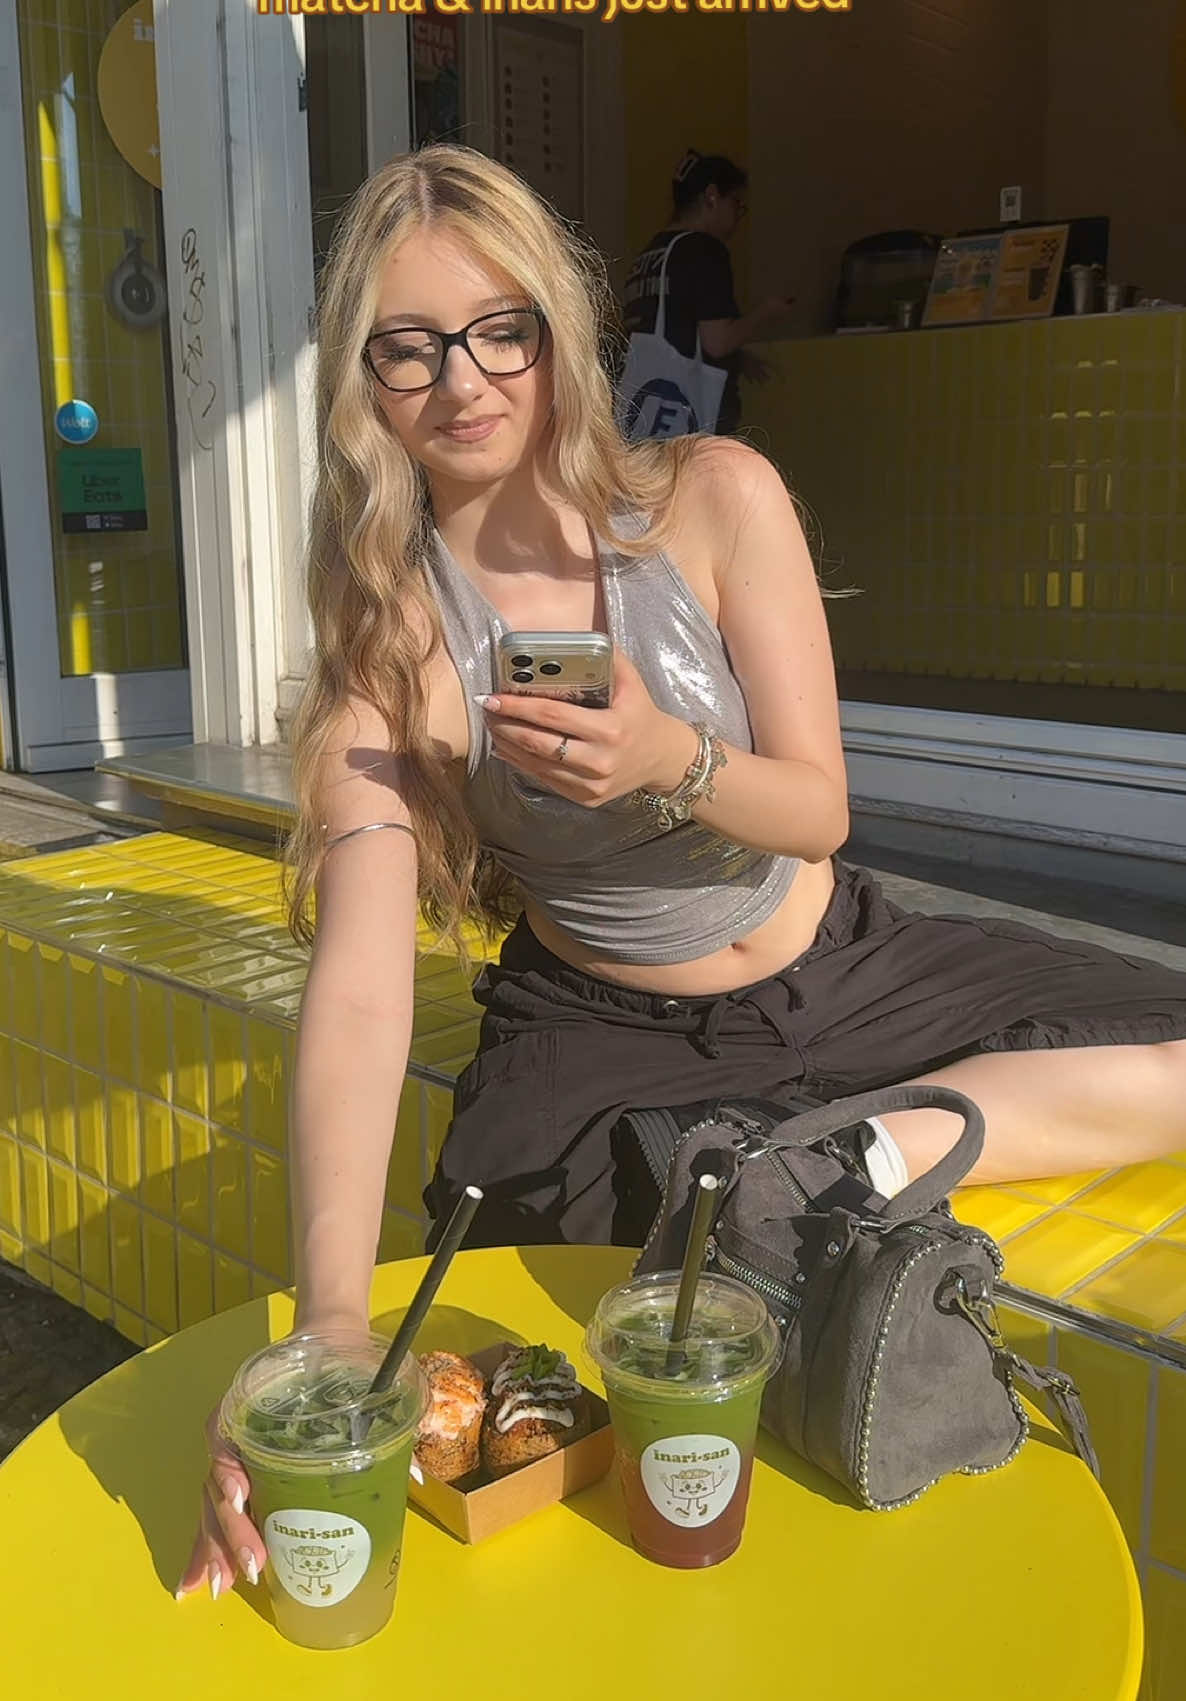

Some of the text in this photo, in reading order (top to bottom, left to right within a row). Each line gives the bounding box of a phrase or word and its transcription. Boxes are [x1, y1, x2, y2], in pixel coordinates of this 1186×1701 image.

[82, 474, 121, 487] Uber
[84, 489, 123, 503] Eats
[653, 1447, 731, 1464] inari-san
[272, 1520, 355, 1540] inari-san
